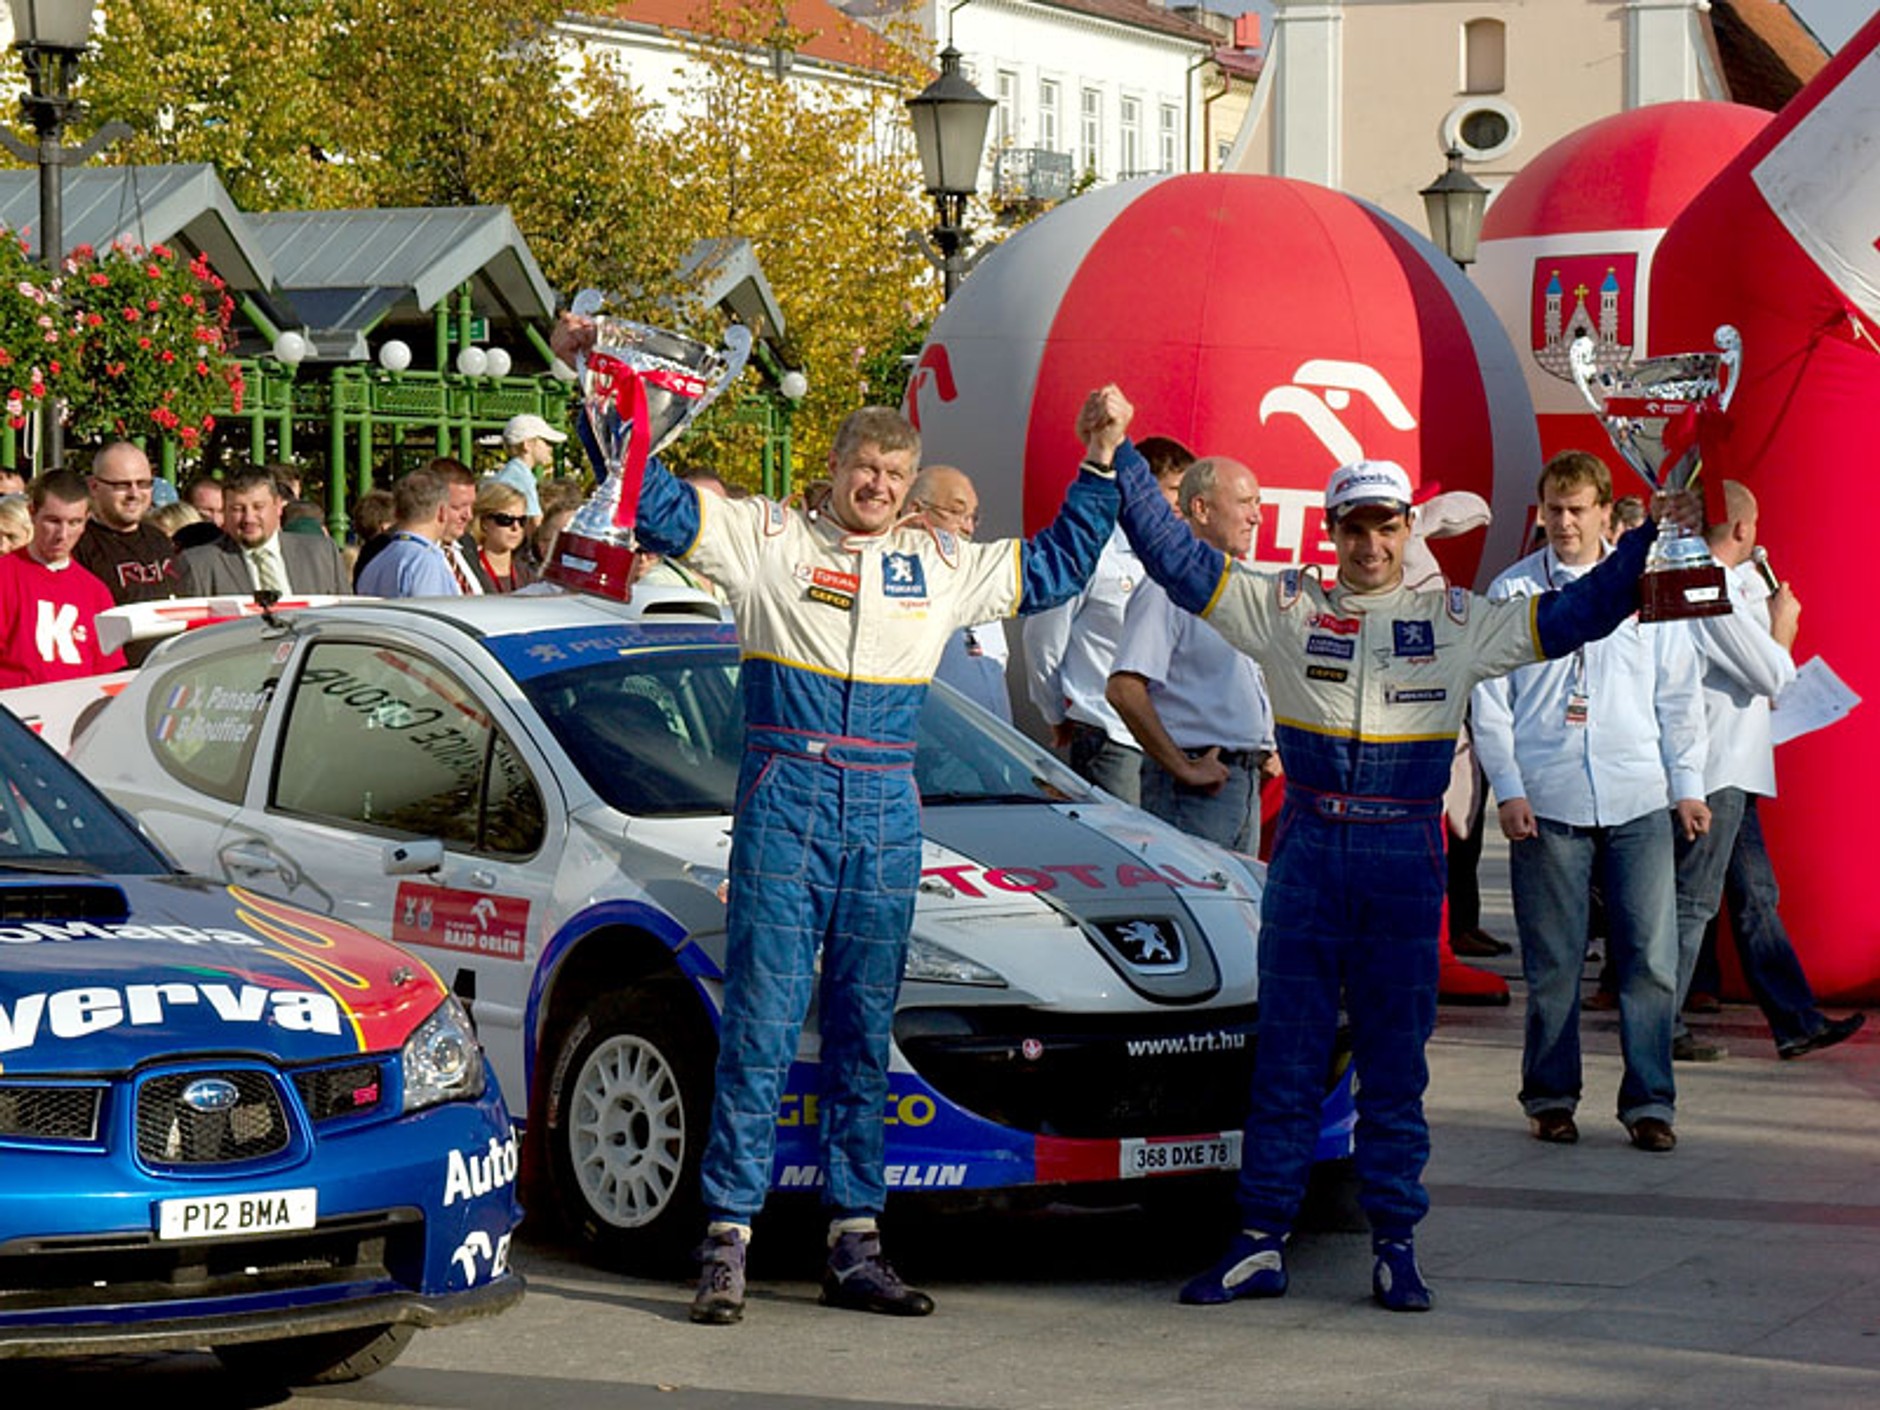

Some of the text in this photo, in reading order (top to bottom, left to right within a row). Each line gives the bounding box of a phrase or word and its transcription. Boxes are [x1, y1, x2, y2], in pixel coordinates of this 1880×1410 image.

[1240, 503, 1340, 565] LE
[815, 571, 858, 588] TOTAL
[810, 589, 850, 607] GEFCO
[921, 863, 1228, 899] TOTAL
[0, 982, 343, 1052] verva
[1127, 1031, 1246, 1057] www.trt.hu
[1137, 1143, 1229, 1169] 368 DXE 78
[183, 1197, 291, 1232] P12 BMA
